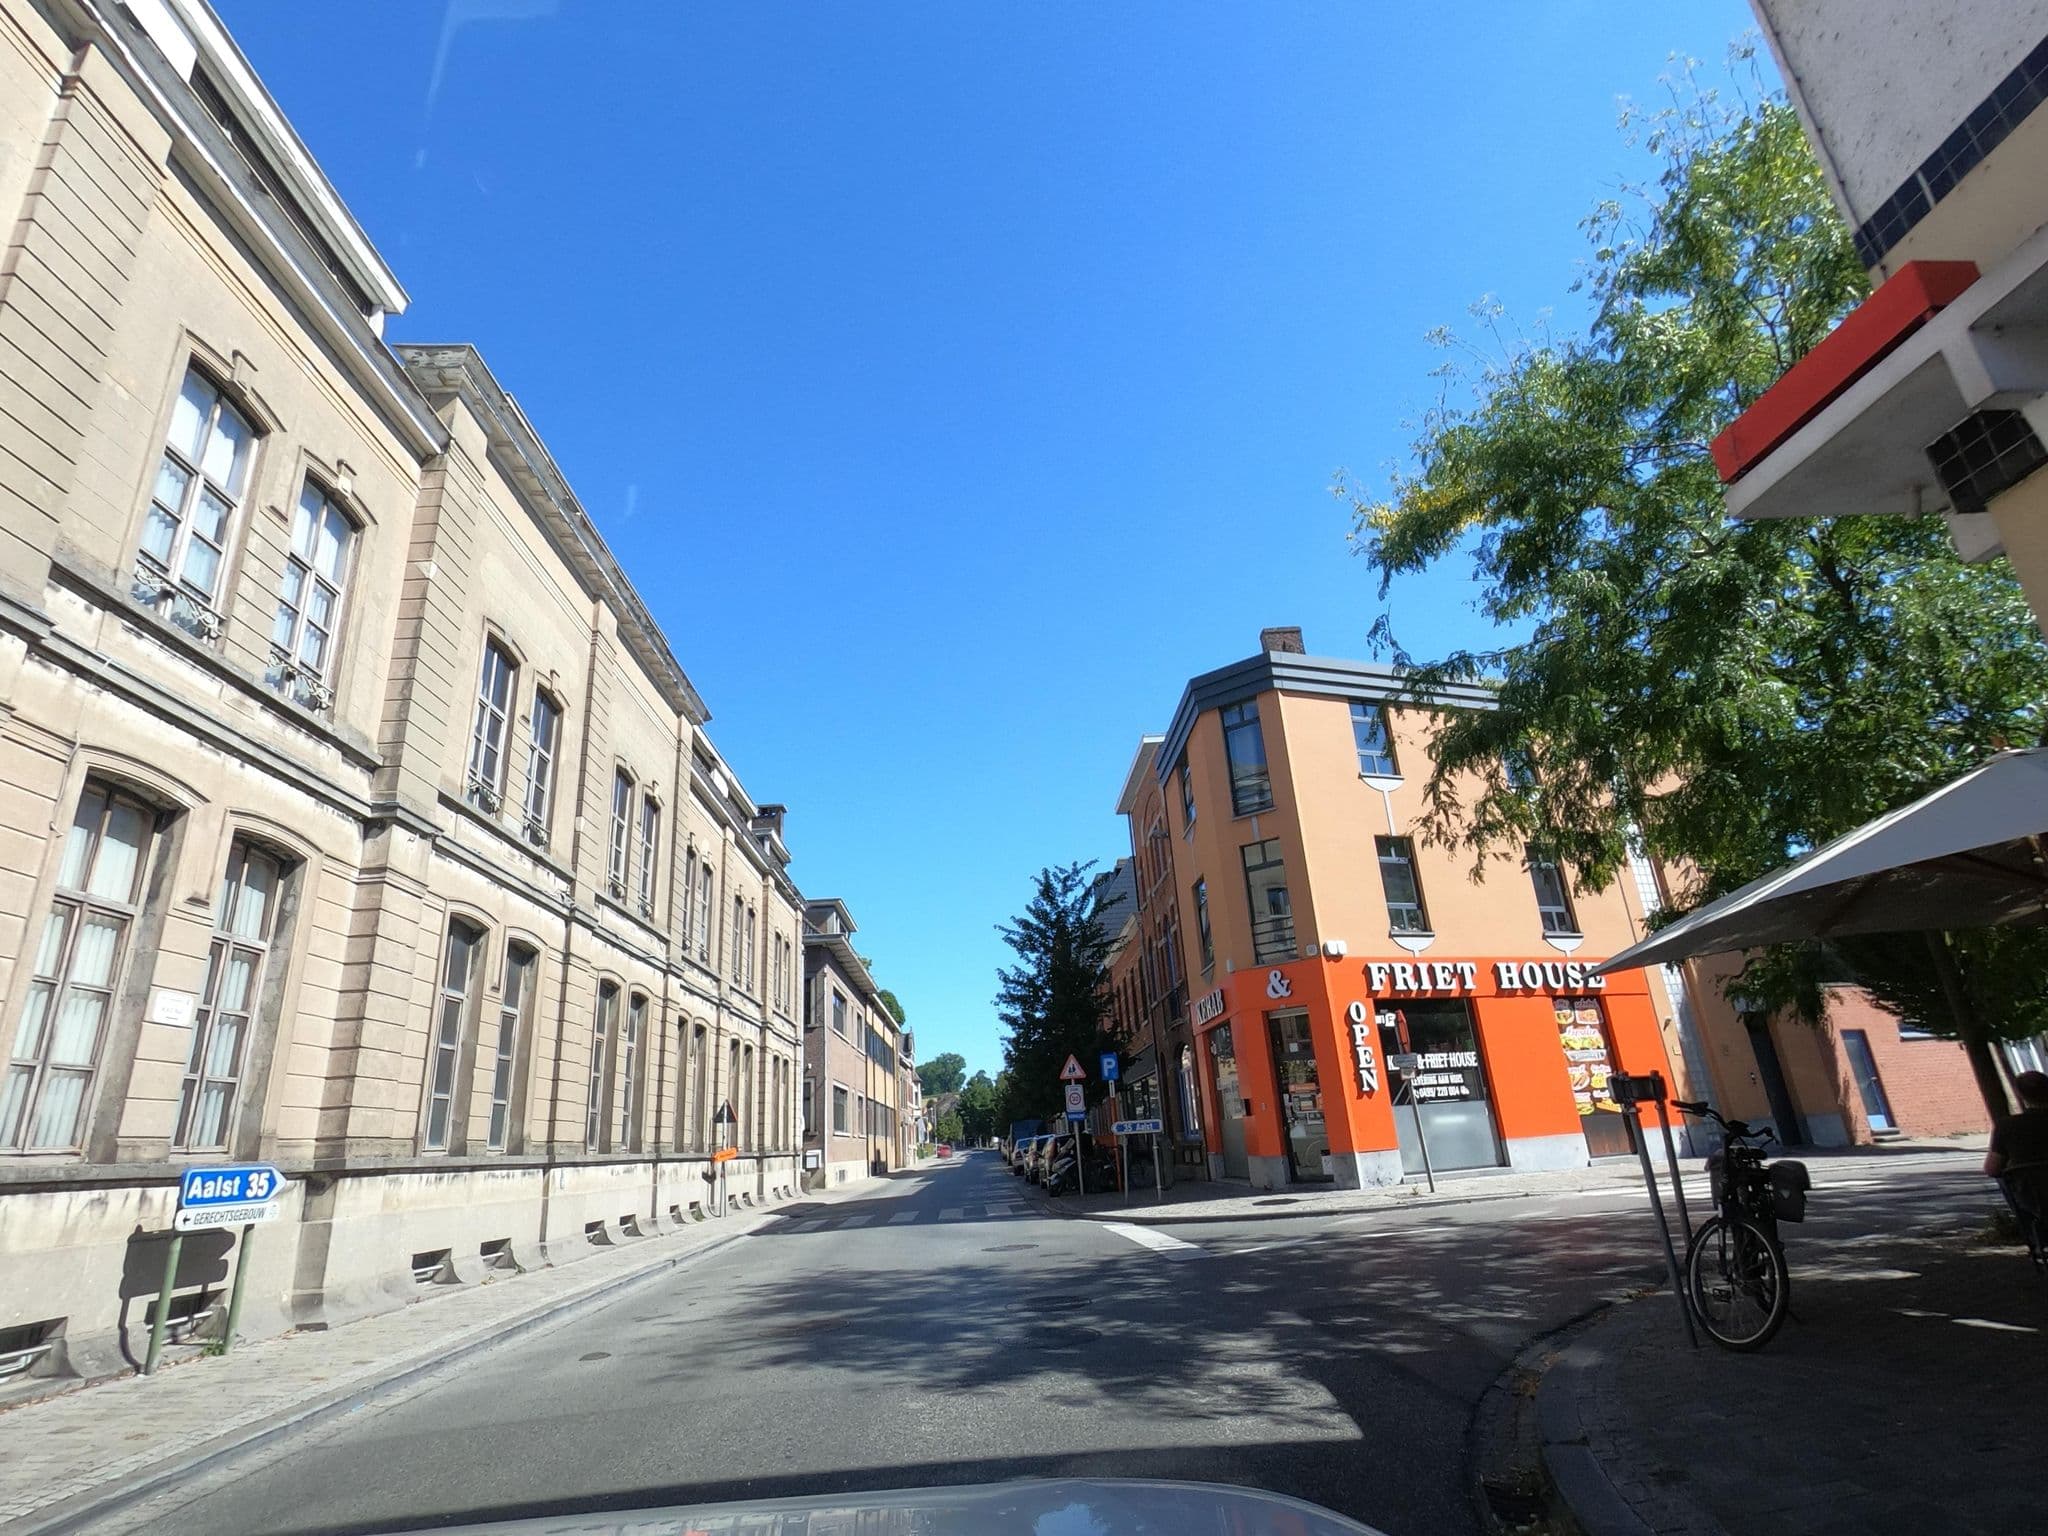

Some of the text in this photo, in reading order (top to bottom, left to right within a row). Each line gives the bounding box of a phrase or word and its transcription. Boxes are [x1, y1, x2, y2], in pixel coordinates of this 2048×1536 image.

[1266, 970, 1291, 999] &
[1366, 961, 1606, 992] FRIET HOUSE
[1195, 988, 1224, 1025] KEBAB
[1348, 1001, 1379, 1092] OPEN
[1424, 1053, 1448, 1069] FRIET
[1448, 1052, 1478, 1067] HOUSE
[1103, 1058, 1115, 1077] P
[187, 1172, 270, 1200] Aalst 35
[193, 1207, 267, 1226] GERECHTSGEBOUW
